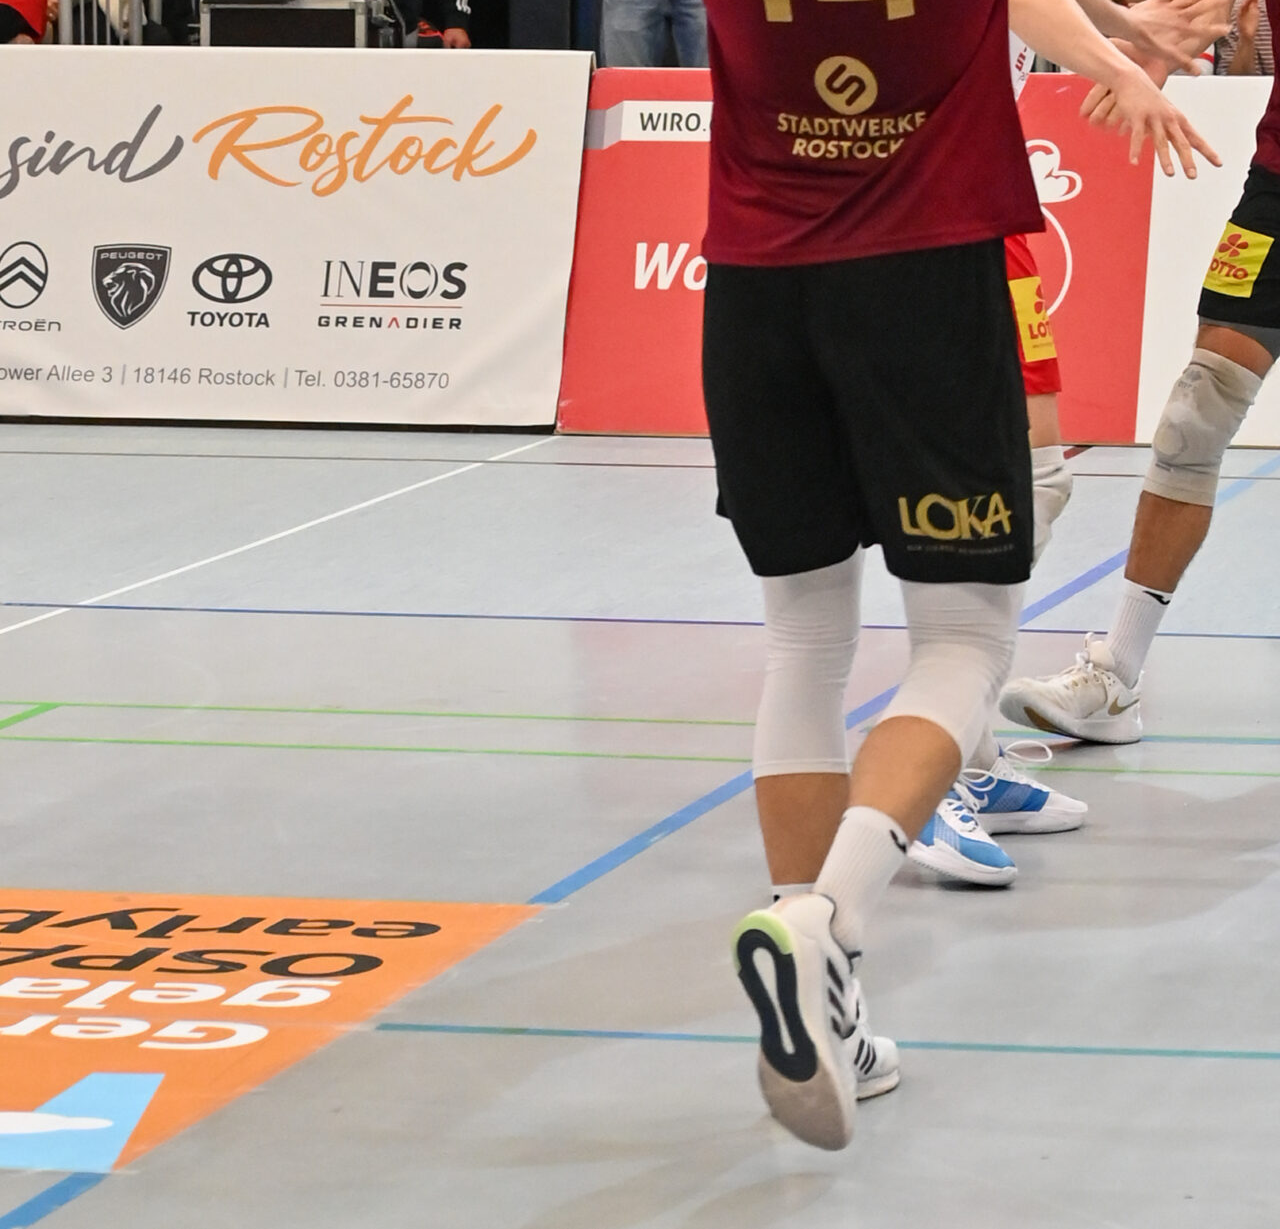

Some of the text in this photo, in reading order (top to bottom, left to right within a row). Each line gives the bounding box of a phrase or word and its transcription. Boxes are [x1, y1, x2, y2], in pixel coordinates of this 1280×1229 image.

[639, 111, 711, 132] WIRO.
[0, 94, 537, 199] sind Rostock
[100, 251, 164, 261] PEUGEOT
[320, 260, 468, 300] INEOS
[187, 310, 270, 329] TOYOTA
[317, 315, 462, 329] GRENADIER
[46, 364, 95, 383] Allee
[101, 366, 113, 383] 3
[133, 366, 191, 385] 18146
[198, 368, 275, 387] Rostock
[295, 369, 326, 387] Tel.
[334, 370, 450, 389] 0381-65870
[898, 491, 1012, 541] LOKA
